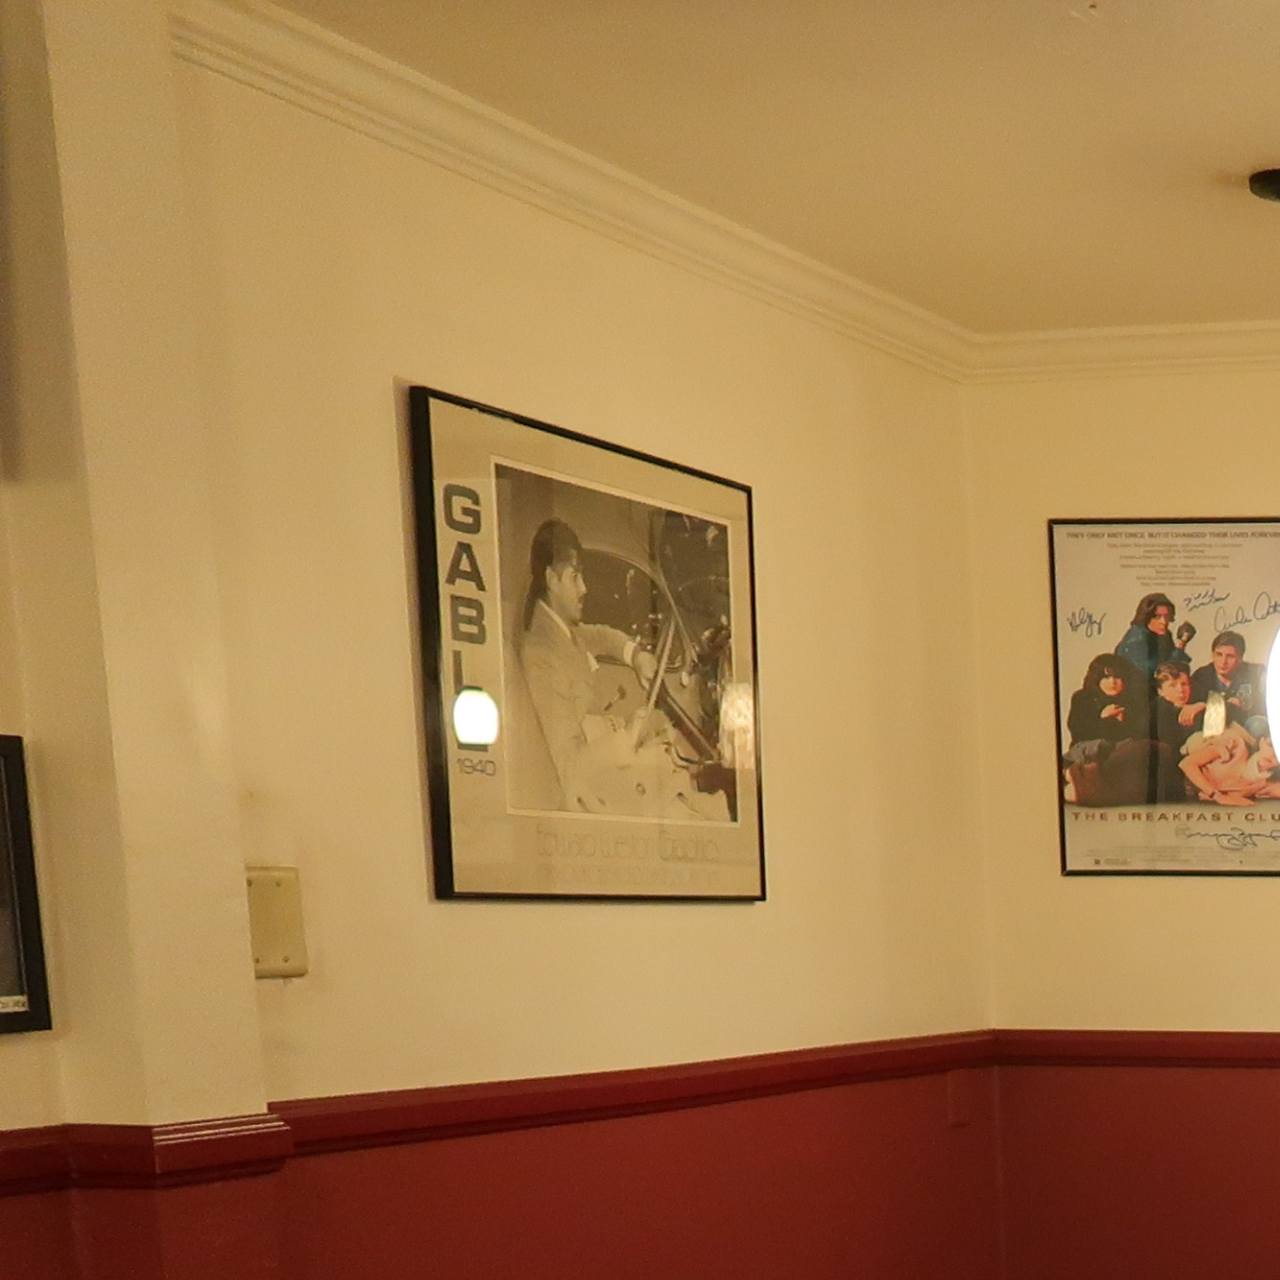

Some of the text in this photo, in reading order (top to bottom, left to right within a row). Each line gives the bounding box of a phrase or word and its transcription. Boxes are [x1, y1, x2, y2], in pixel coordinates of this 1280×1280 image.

[443, 483, 488, 752] GABL
[457, 758, 497, 776] 1940
[1071, 811, 1108, 822] THE
[1118, 811, 1234, 822] BREAKFAST
